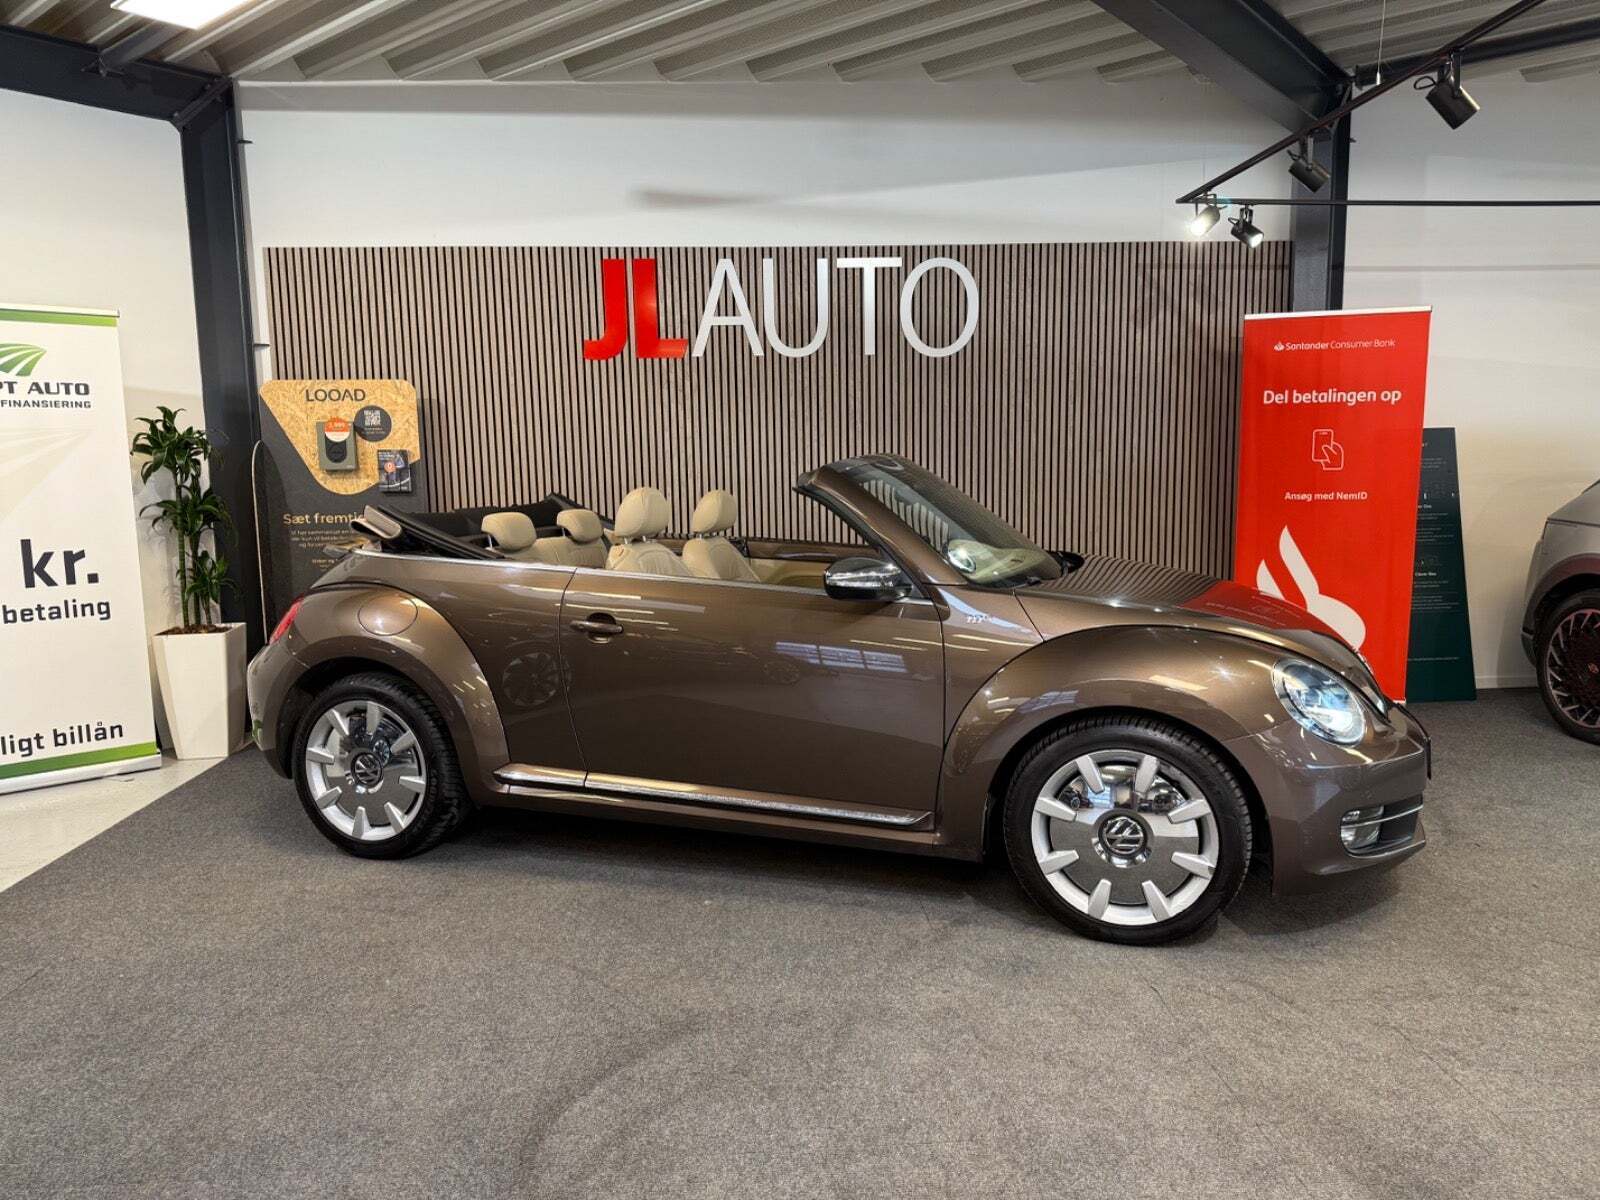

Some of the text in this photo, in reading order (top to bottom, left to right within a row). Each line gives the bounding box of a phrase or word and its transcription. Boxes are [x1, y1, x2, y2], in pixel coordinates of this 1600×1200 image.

[583, 256, 980, 361] JL AUTO
[1286, 338, 1396, 350] Santander Consumer Bank
[27, 381, 90, 396] AUTO
[305, 388, 367, 402] LOOAD
[1263, 388, 1402, 407] Del betalingen op
[1284, 491, 1368, 502] Ansøg med NemID
[282, 513, 311, 525] Sæt
[20, 538, 99, 589] kr.
[2, 598, 111, 624] betaling
[0, 721, 124, 758] ligt billån
